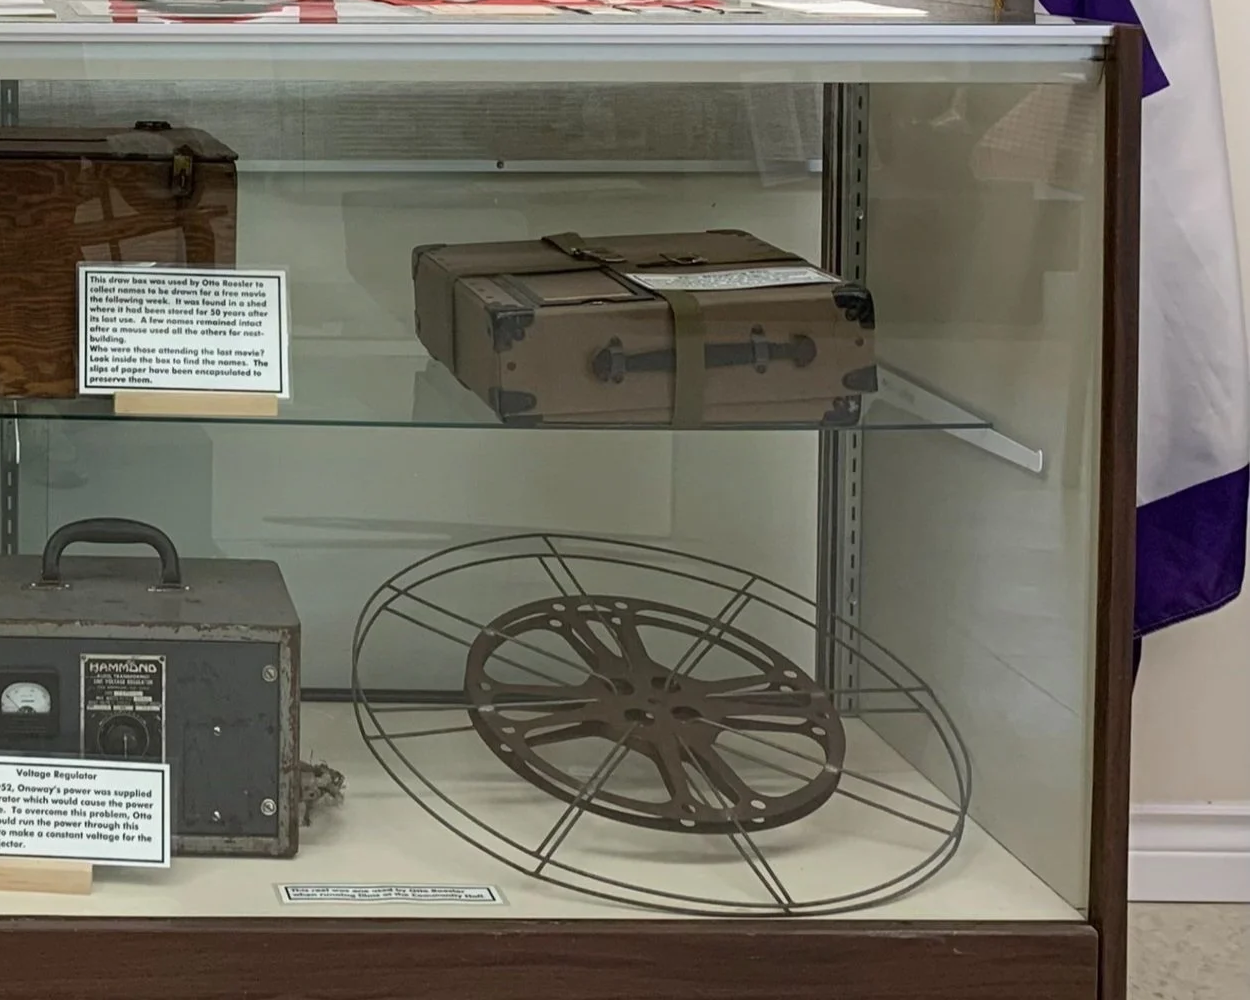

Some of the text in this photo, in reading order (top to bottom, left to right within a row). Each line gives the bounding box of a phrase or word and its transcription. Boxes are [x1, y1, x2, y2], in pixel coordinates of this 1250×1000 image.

[89, 275, 264, 289] This draw box was used by Otto Roesler to
[89, 334, 127, 346] building.
[89, 353, 269, 367] Look inside the box to find the names. The
[89, 374, 153, 386] preserve them.
[89, 661, 157, 673] HAMMOND
[16, 768, 98, 783] Voltage Regulator
[17, 783, 61, 797] Onoway's
[63, 787, 92, 798] power
[93, 788, 112, 796] was
[113, 787, 153, 801] supplied
[22, 795, 49, 805] which
[50, 796, 78, 806] would
[80, 799, 106, 807] cause
[108, 798, 123, 808] the
[125, 801, 154, 812] power
[11, 805, 23, 815] To
[24, 808, 68, 817] overcome
[70, 808, 87, 818] this
[89, 808, 130, 822] problem,
[132, 810, 152, 820] Otto
[18, 819, 35, 827] run
[36, 817, 52, 827] the
[53, 820, 82, 831] power
[84, 819, 121, 833] through
[122, 821, 139, 830] this
[8, 828, 35, 838] make
[45, 829, 84, 840] constant
[85, 831, 120, 844] voltage
[122, 832, 136, 842] for
[137, 833, 152, 842] the
